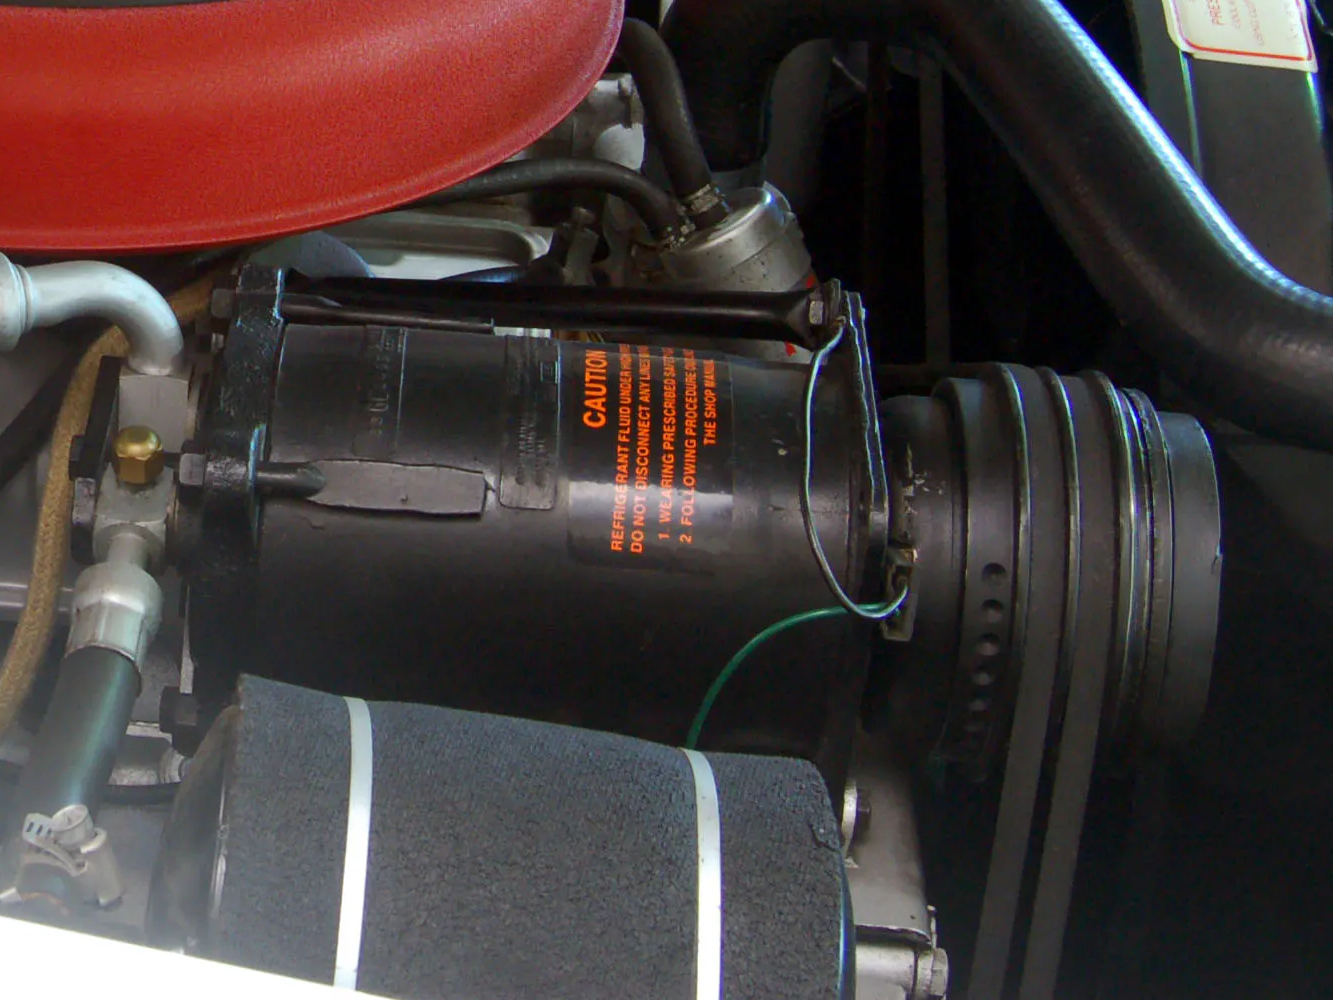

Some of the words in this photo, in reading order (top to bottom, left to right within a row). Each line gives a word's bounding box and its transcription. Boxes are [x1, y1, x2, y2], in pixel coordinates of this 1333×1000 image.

[583, 349, 608, 429] CAUTION
[619, 371, 633, 403] UNDER
[638, 381, 651, 404] ANY
[684, 370, 698, 437] PROCEDURE
[704, 389, 717, 420] SHOP
[617, 404, 632, 443] FLUID
[662, 379, 677, 451] PRESCRIBED
[703, 421, 717, 445] THE
[634, 404, 651, 491] DISCONNECT
[610, 445, 631, 552] REFRIGERANT
[659, 453, 675, 524] WEARING
[680, 440, 698, 526] FOLLOWING
[632, 495, 647, 527] NOT
[630, 530, 645, 554] DO
